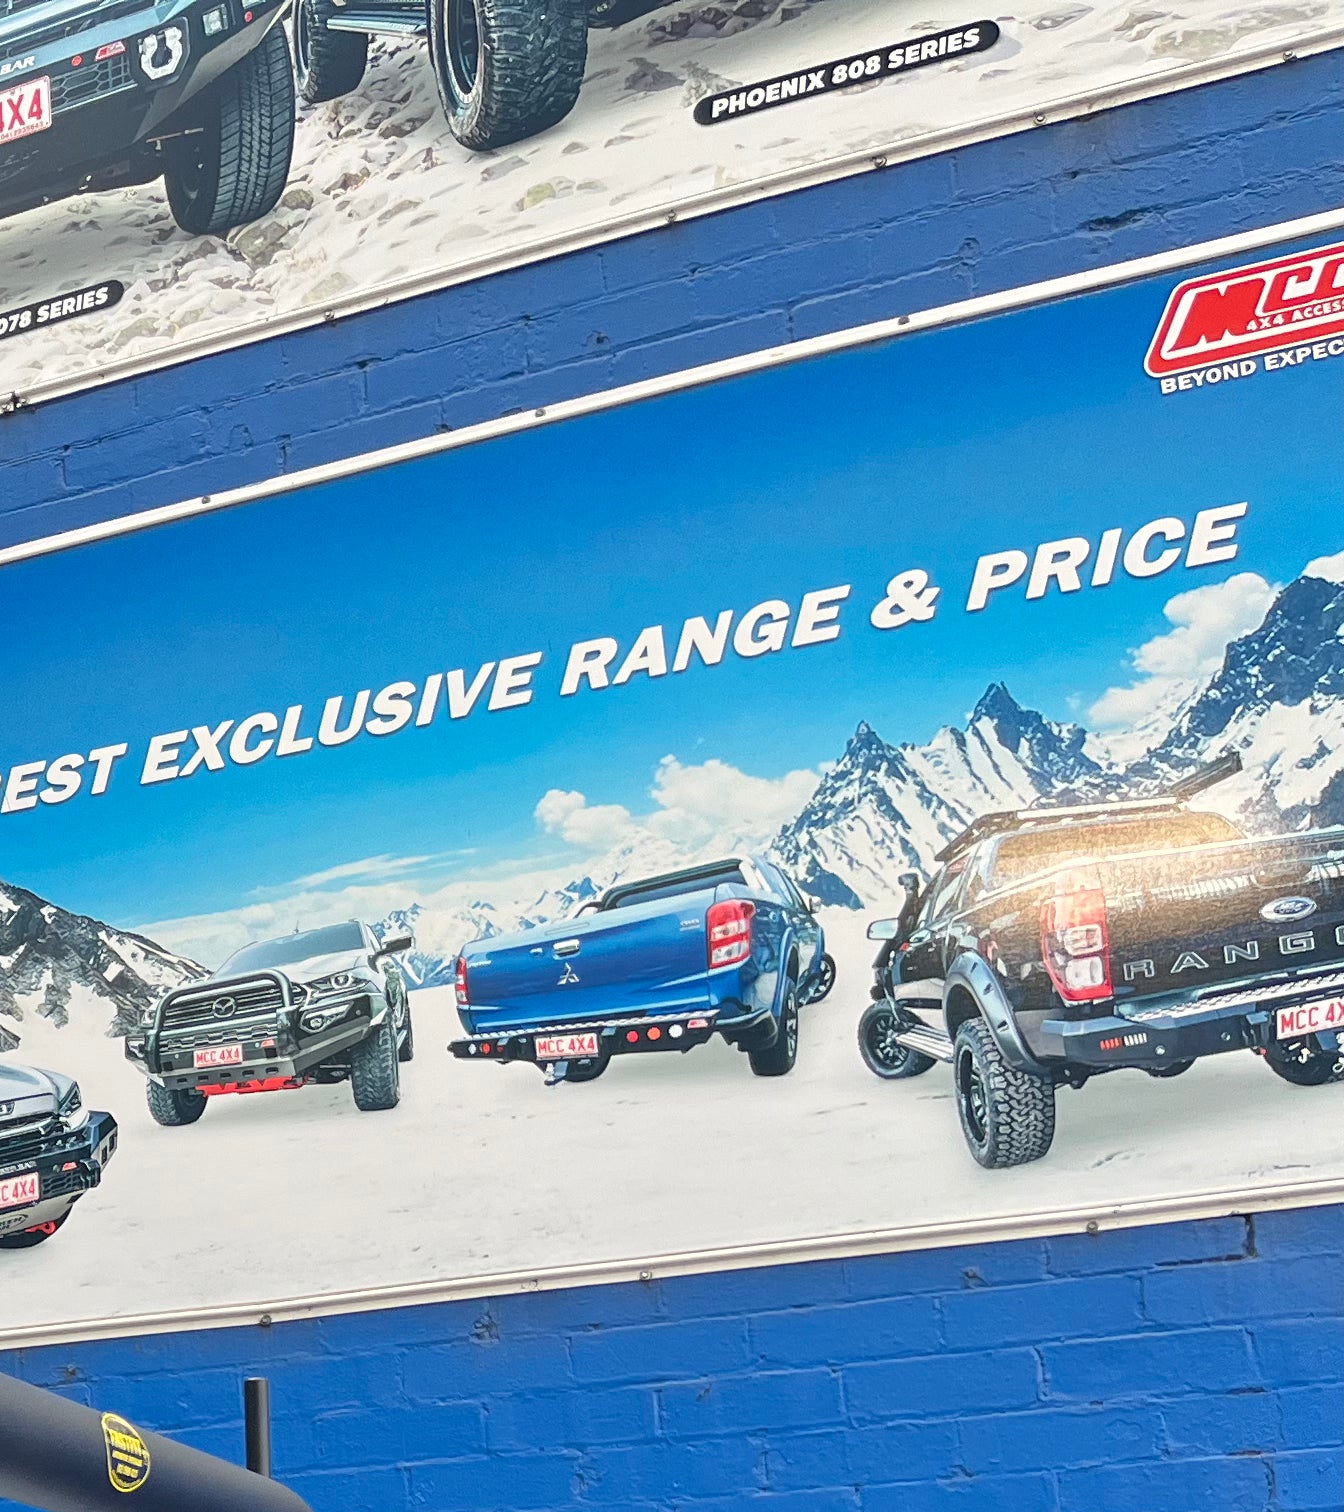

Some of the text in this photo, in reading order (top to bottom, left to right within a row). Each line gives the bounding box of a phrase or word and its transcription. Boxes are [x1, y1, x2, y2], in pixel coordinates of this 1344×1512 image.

[0, 56, 35, 75] BAR
[712, 28, 980, 118] PHOENIX 808 SERIES
[37, 286, 109, 324] SERIES
[1246, 300, 1344, 331] 4X4 ACCES
[1160, 339, 1344, 394] BEYOND EXPEC
[140, 651, 542, 784] EXCLUSIVE
[559, 584, 851, 697] RANGE
[869, 568, 941, 630] &
[965, 501, 1248, 612] PRICE
[1123, 925, 1344, 981] RANG
[1281, 1006, 1319, 1034] MCC
[196, 1048, 240, 1063] MCC 4X4
[538, 1036, 595, 1054] MCC 4X4
[13, 1178, 35, 1200] 4X4
